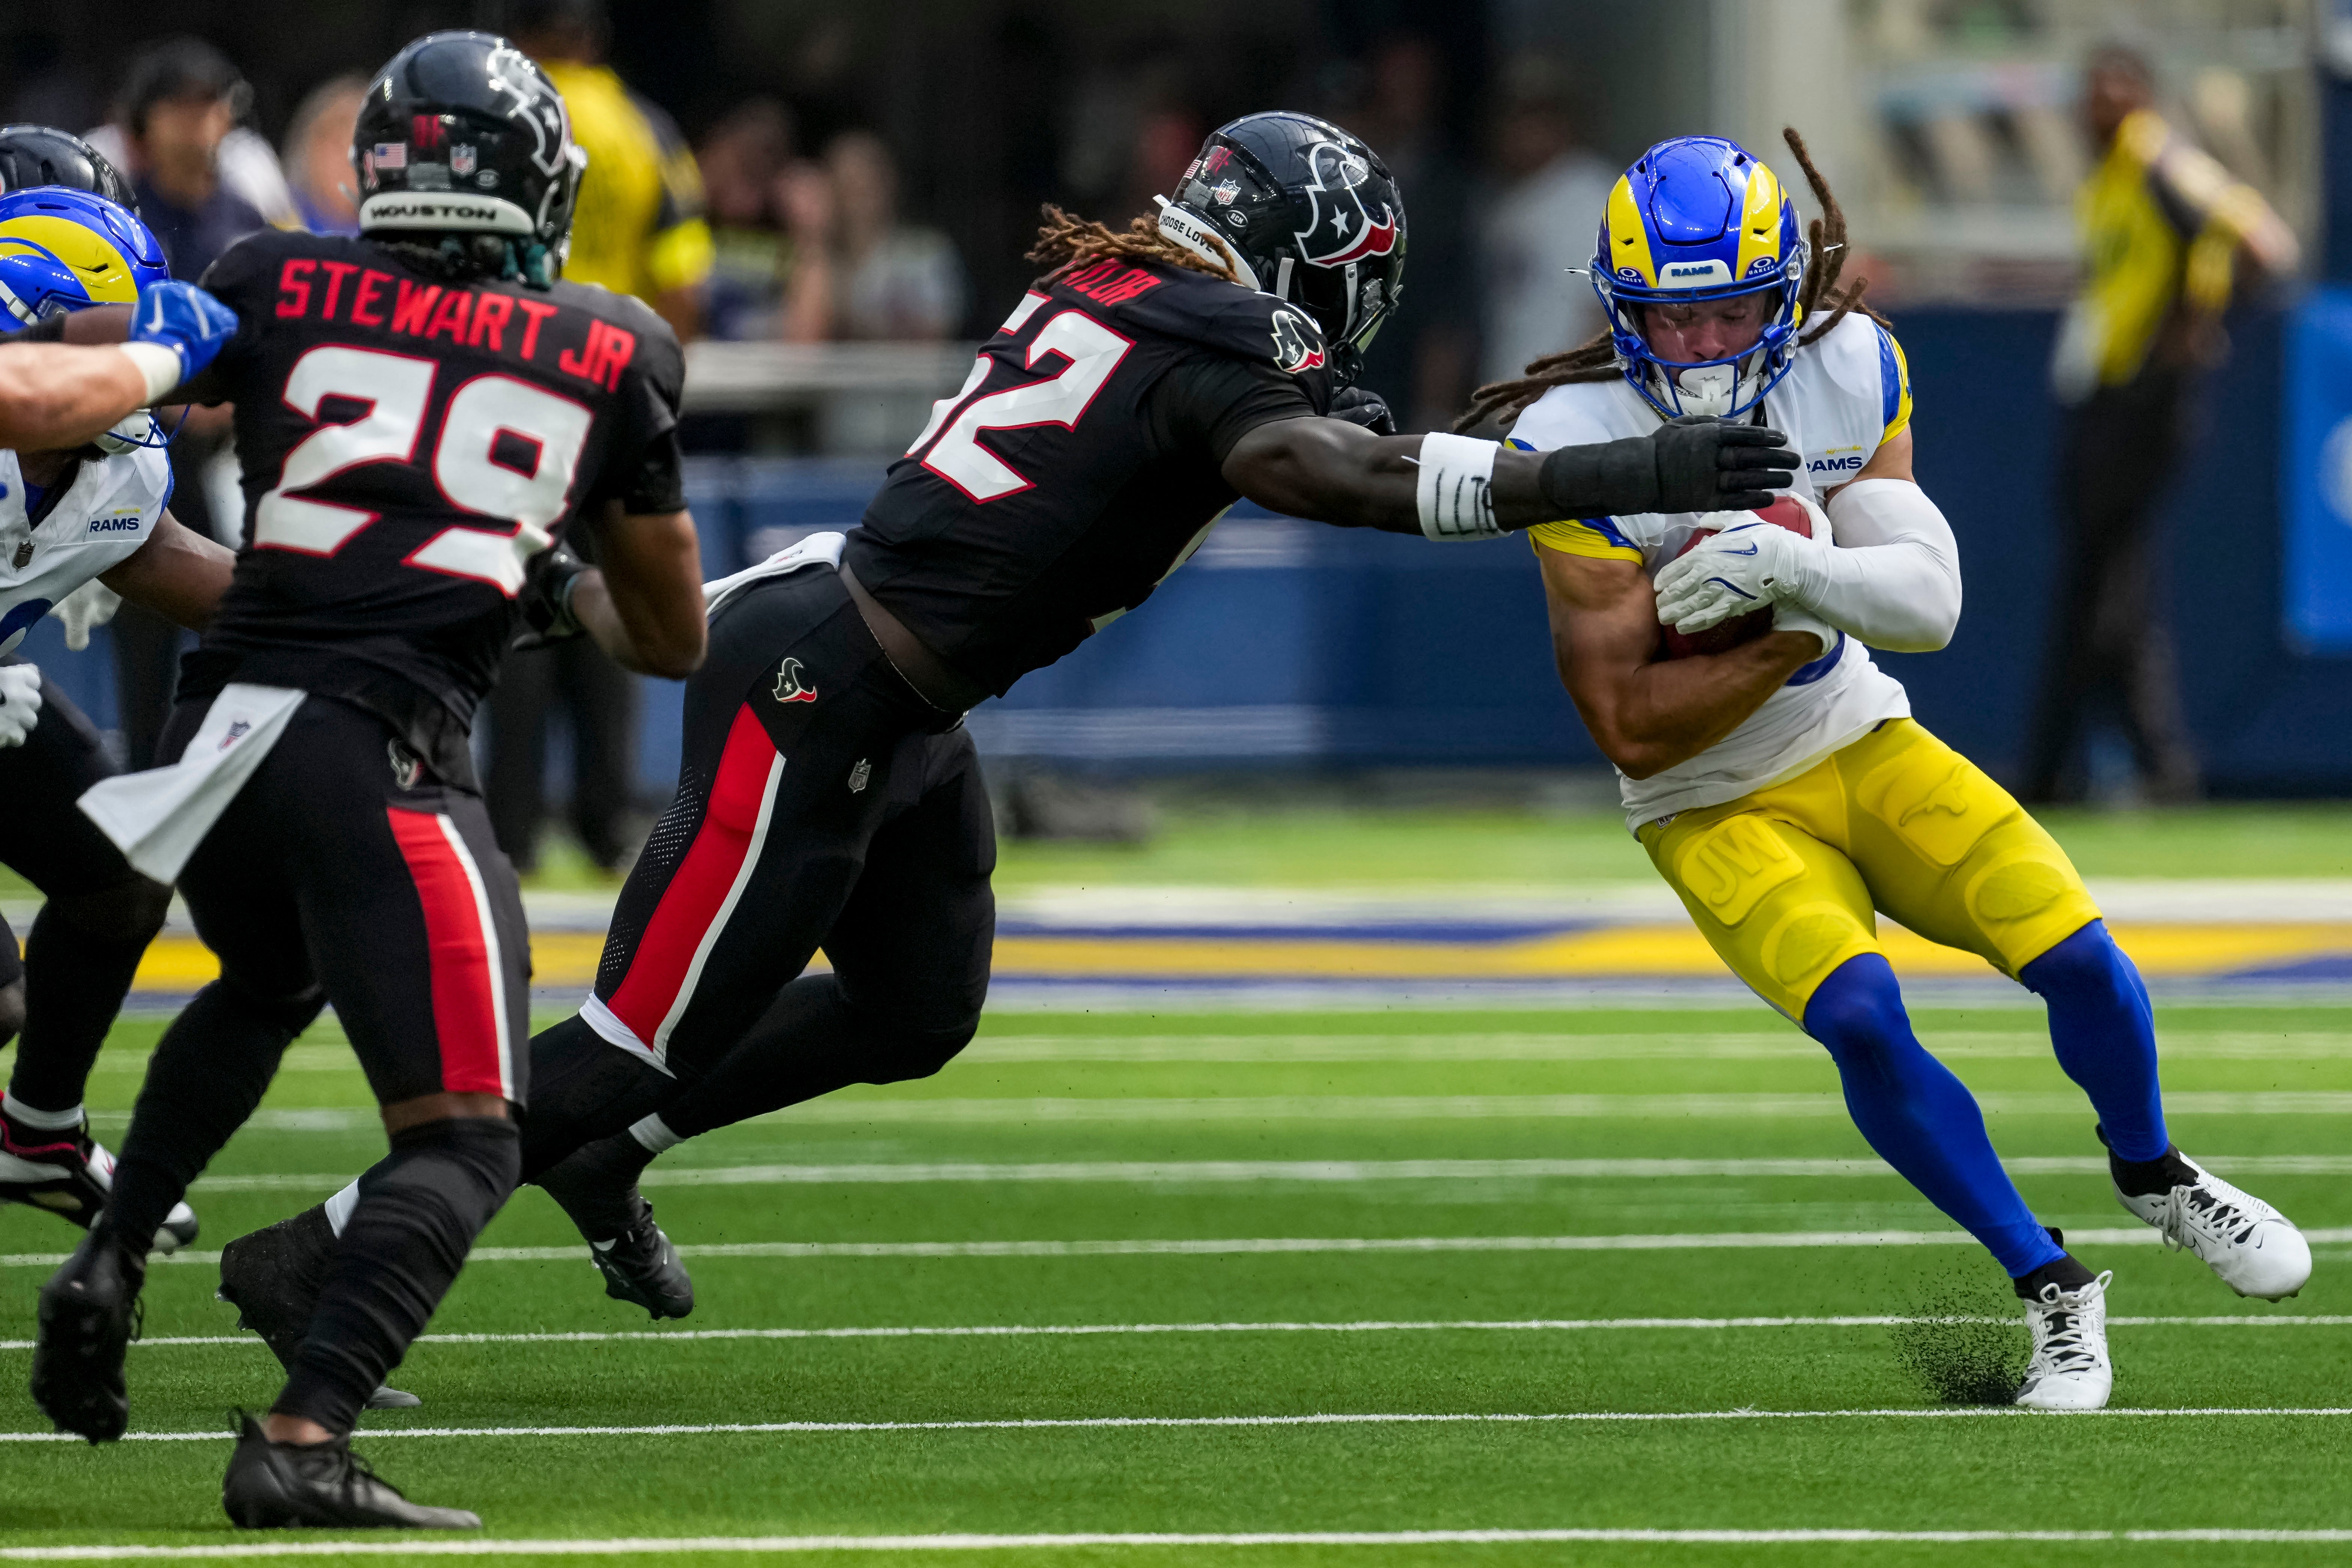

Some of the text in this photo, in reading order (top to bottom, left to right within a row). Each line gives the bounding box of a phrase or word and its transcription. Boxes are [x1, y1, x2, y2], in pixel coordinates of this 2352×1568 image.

[371, 205, 498, 221] HOUSTON
[1671, 265, 1714, 277] RAMS
[1749, 265, 1775, 275] OAKLEY
[276, 258, 636, 393] STEWART JR
[254, 343, 596, 599] 29
[89, 517, 139, 533] RAMS
[1697, 818, 1788, 905] JW
